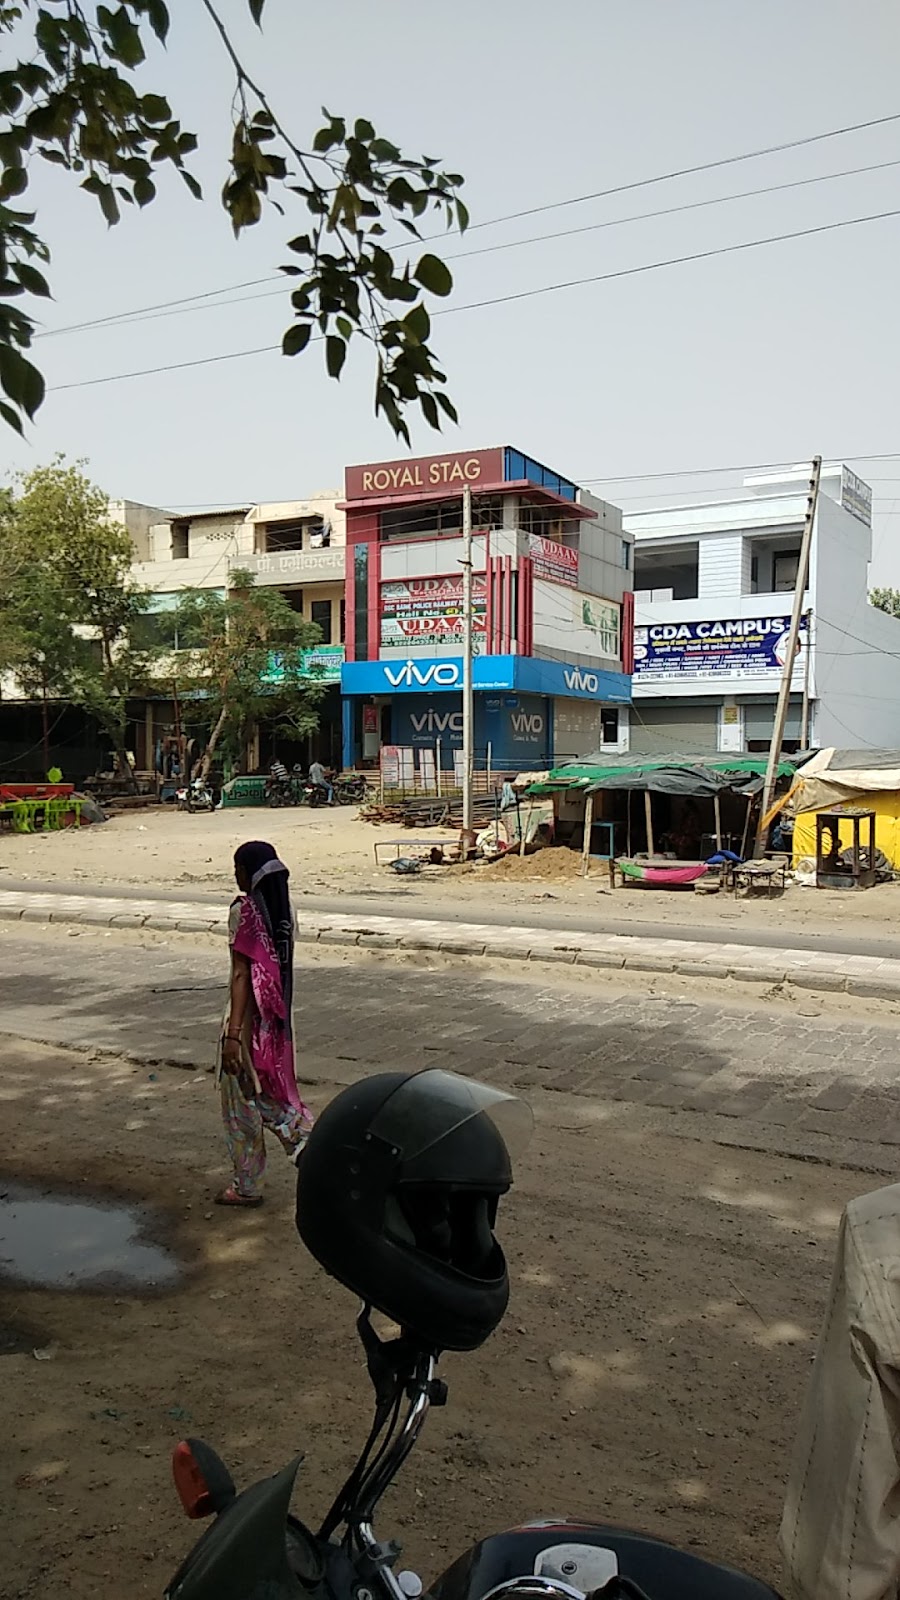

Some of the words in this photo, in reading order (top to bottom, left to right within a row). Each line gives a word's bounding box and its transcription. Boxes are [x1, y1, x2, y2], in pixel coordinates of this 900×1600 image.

[362, 466, 424, 491] ROYAL
[429, 458, 481, 484] STAG
[543, 538, 578, 561] UDAAN
[396, 610, 420, 618] Hall
[423, 609, 443, 617] No.
[402, 615, 486, 631] UDAAN
[650, 625, 691, 640] CDA
[696, 618, 785, 637] CAMPUS
